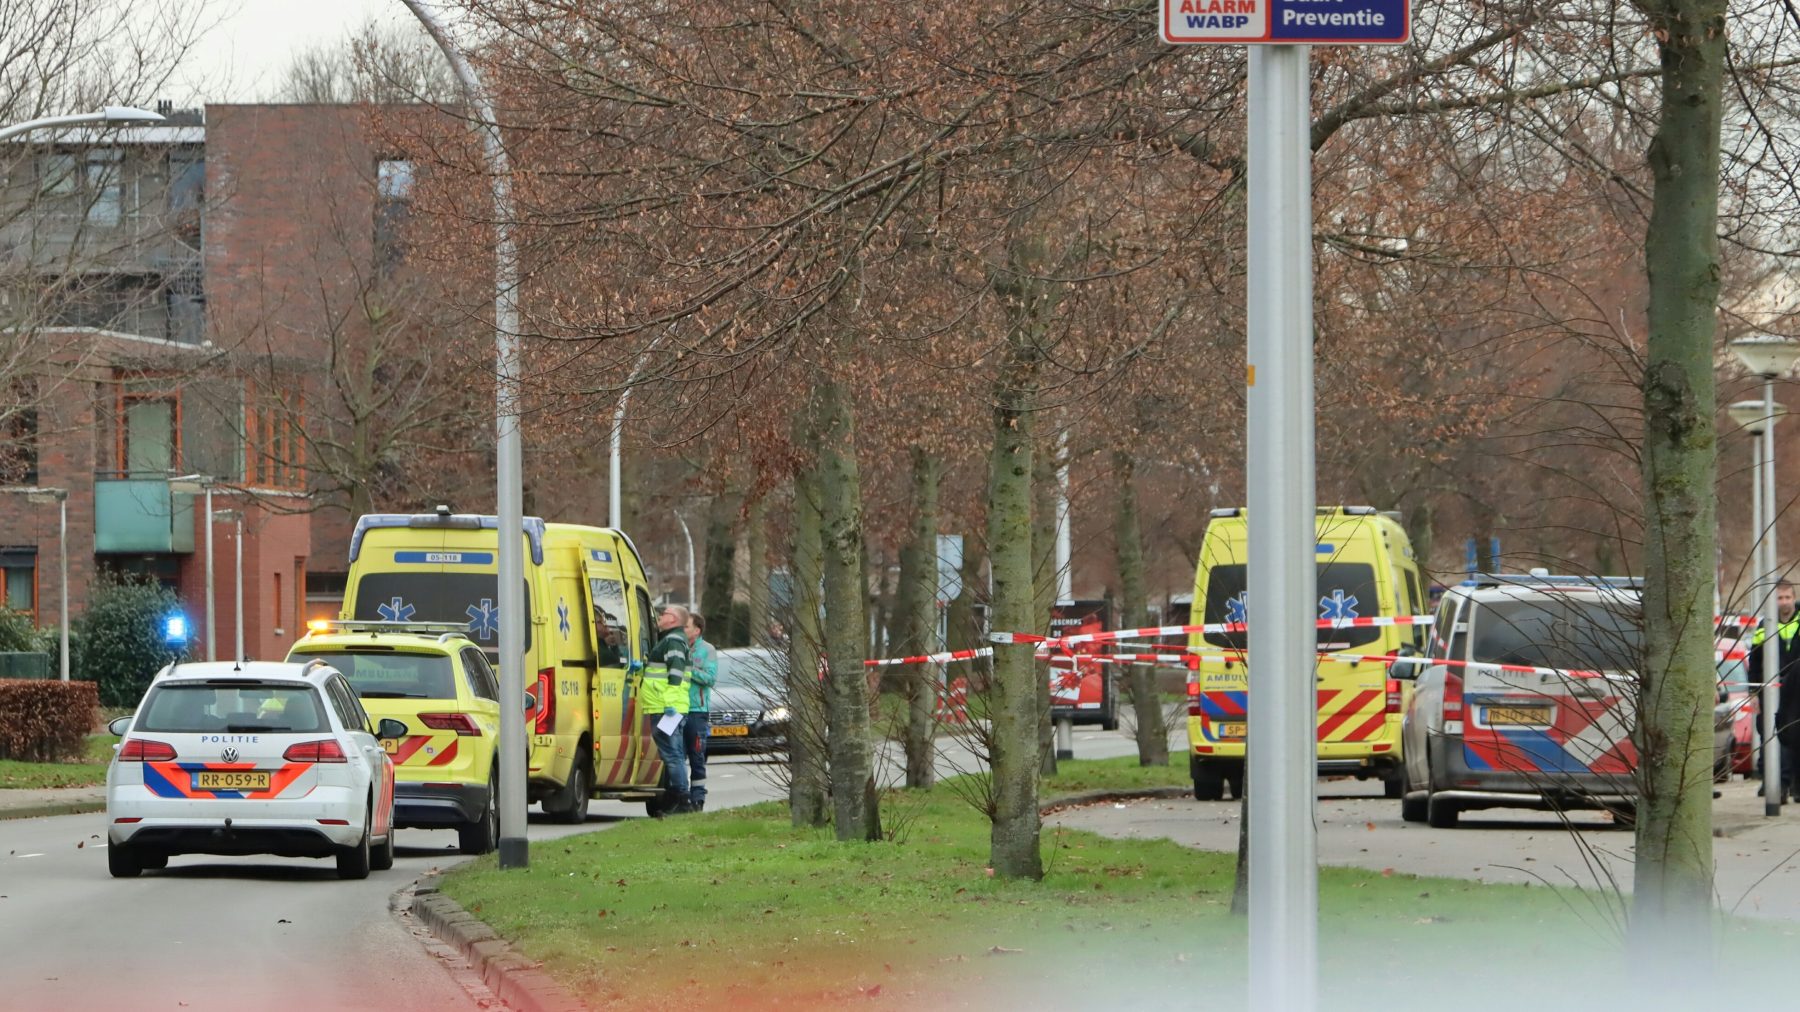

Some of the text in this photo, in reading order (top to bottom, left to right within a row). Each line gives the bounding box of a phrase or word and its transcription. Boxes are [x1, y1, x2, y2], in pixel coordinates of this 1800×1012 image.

[1179, 0, 1256, 13] ALARM
[1186, 15, 1249, 28] WABP
[1282, 9, 1385, 26] Preventie
[201, 735, 260, 743] POLITIE
[202, 774, 266, 786] RR-059-R
